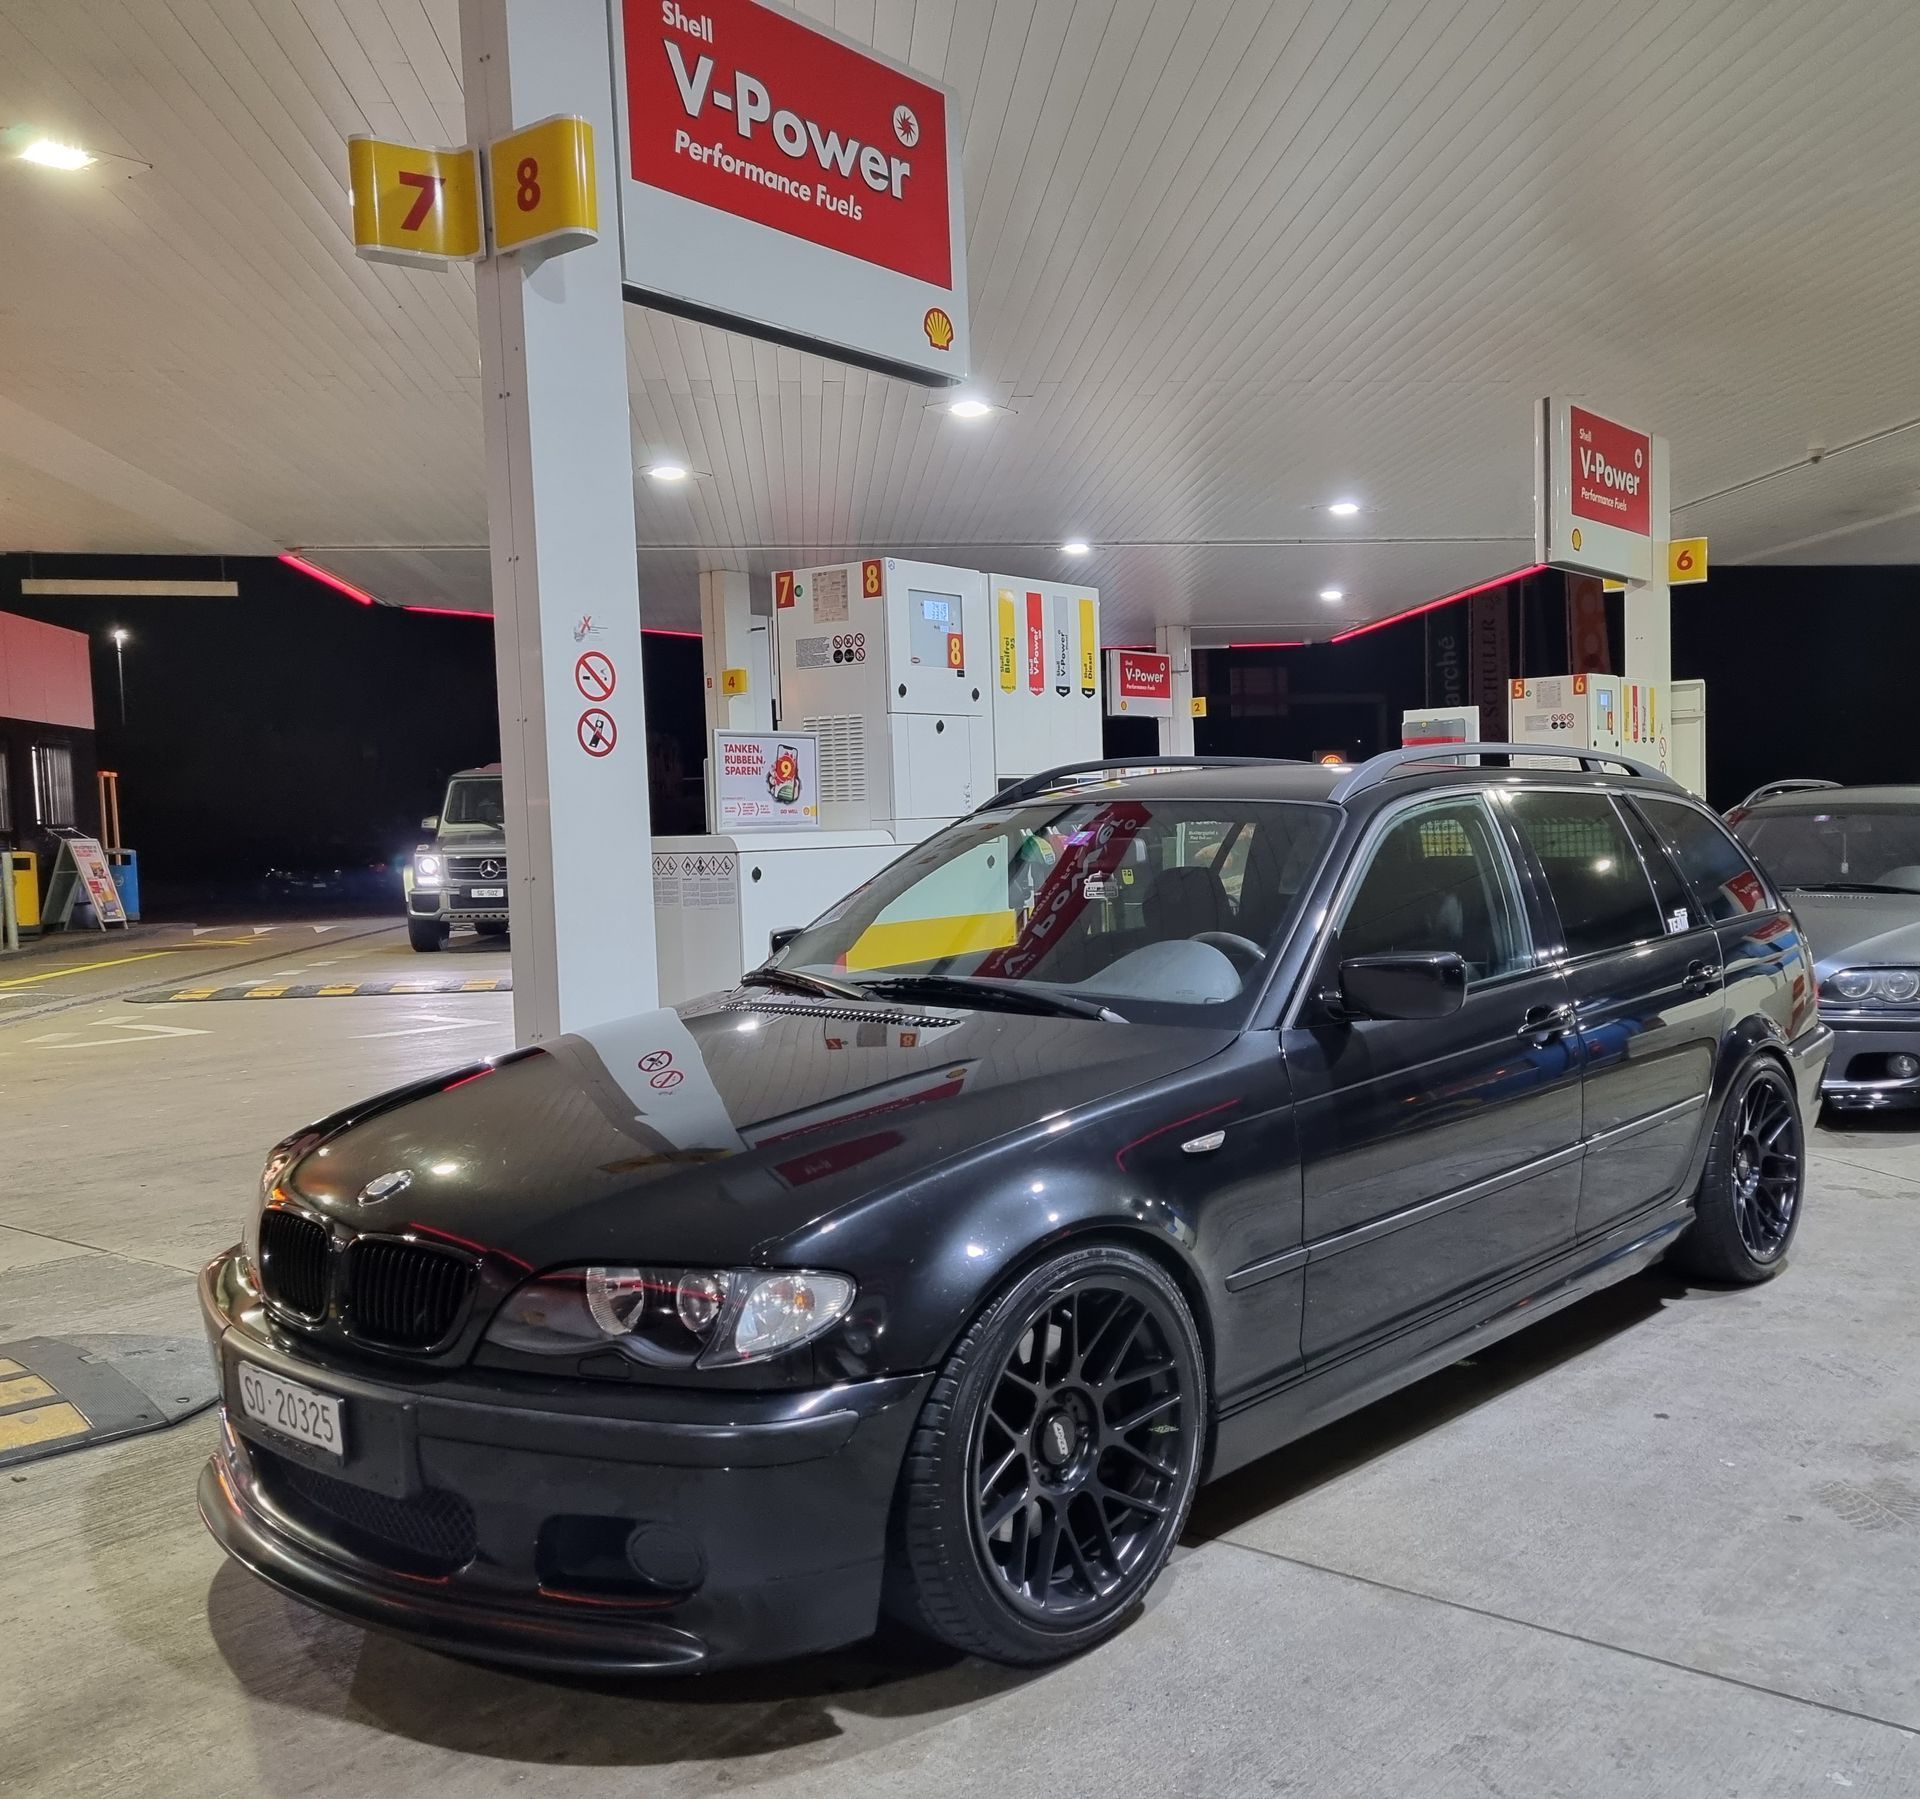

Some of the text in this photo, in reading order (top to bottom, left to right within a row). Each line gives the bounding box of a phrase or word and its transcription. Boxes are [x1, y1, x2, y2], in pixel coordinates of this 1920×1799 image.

[662, 0, 713, 43] Shell
[664, 38, 911, 200] V-Power
[516, 157, 541, 212] 8
[675, 129, 863, 221] Performance Fuels
[398, 170, 446, 231] 7
[1580, 428, 1592, 442] Shell
[1580, 446, 1640, 495] V-Power
[1581, 486, 1627, 512] Performance Fuels
[1676, 549, 1694, 572] 6
[780, 576, 791, 604] 7
[866, 564, 879, 594] 8
[951, 637, 961, 665] 8
[728, 676, 736, 688] 4
[1125, 668, 1164, 683] V-Power
[1575, 677, 1584, 692] 6
[1514, 681, 1523, 697] 5
[1194, 702, 1200, 711] 2
[723, 744, 762, 754] TANKEN,
[724, 755, 766, 765] RUBBELN,
[781, 761, 792, 777] 9
